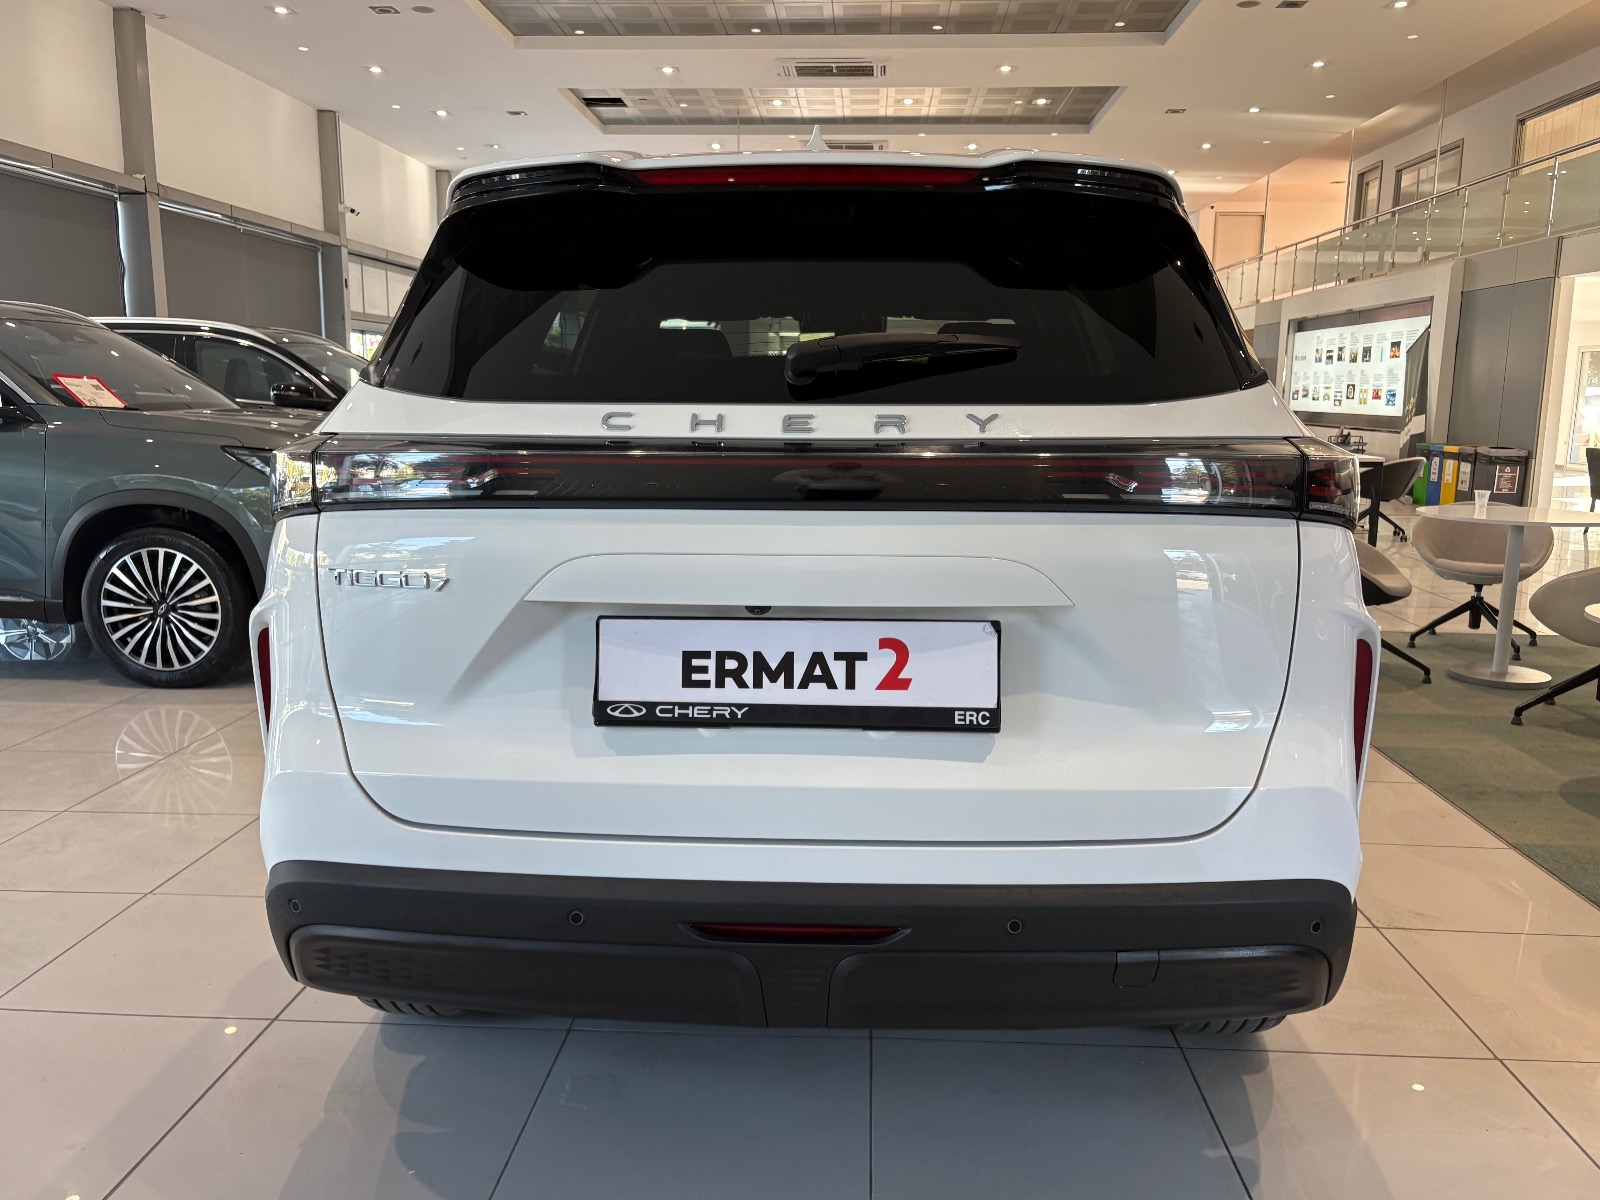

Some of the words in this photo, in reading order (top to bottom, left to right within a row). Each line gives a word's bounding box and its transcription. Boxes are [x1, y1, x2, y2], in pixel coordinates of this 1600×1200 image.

[601, 411, 999, 433] CHERY
[655, 704, 750, 719] CHERY
[954, 711, 991, 726] ERC
